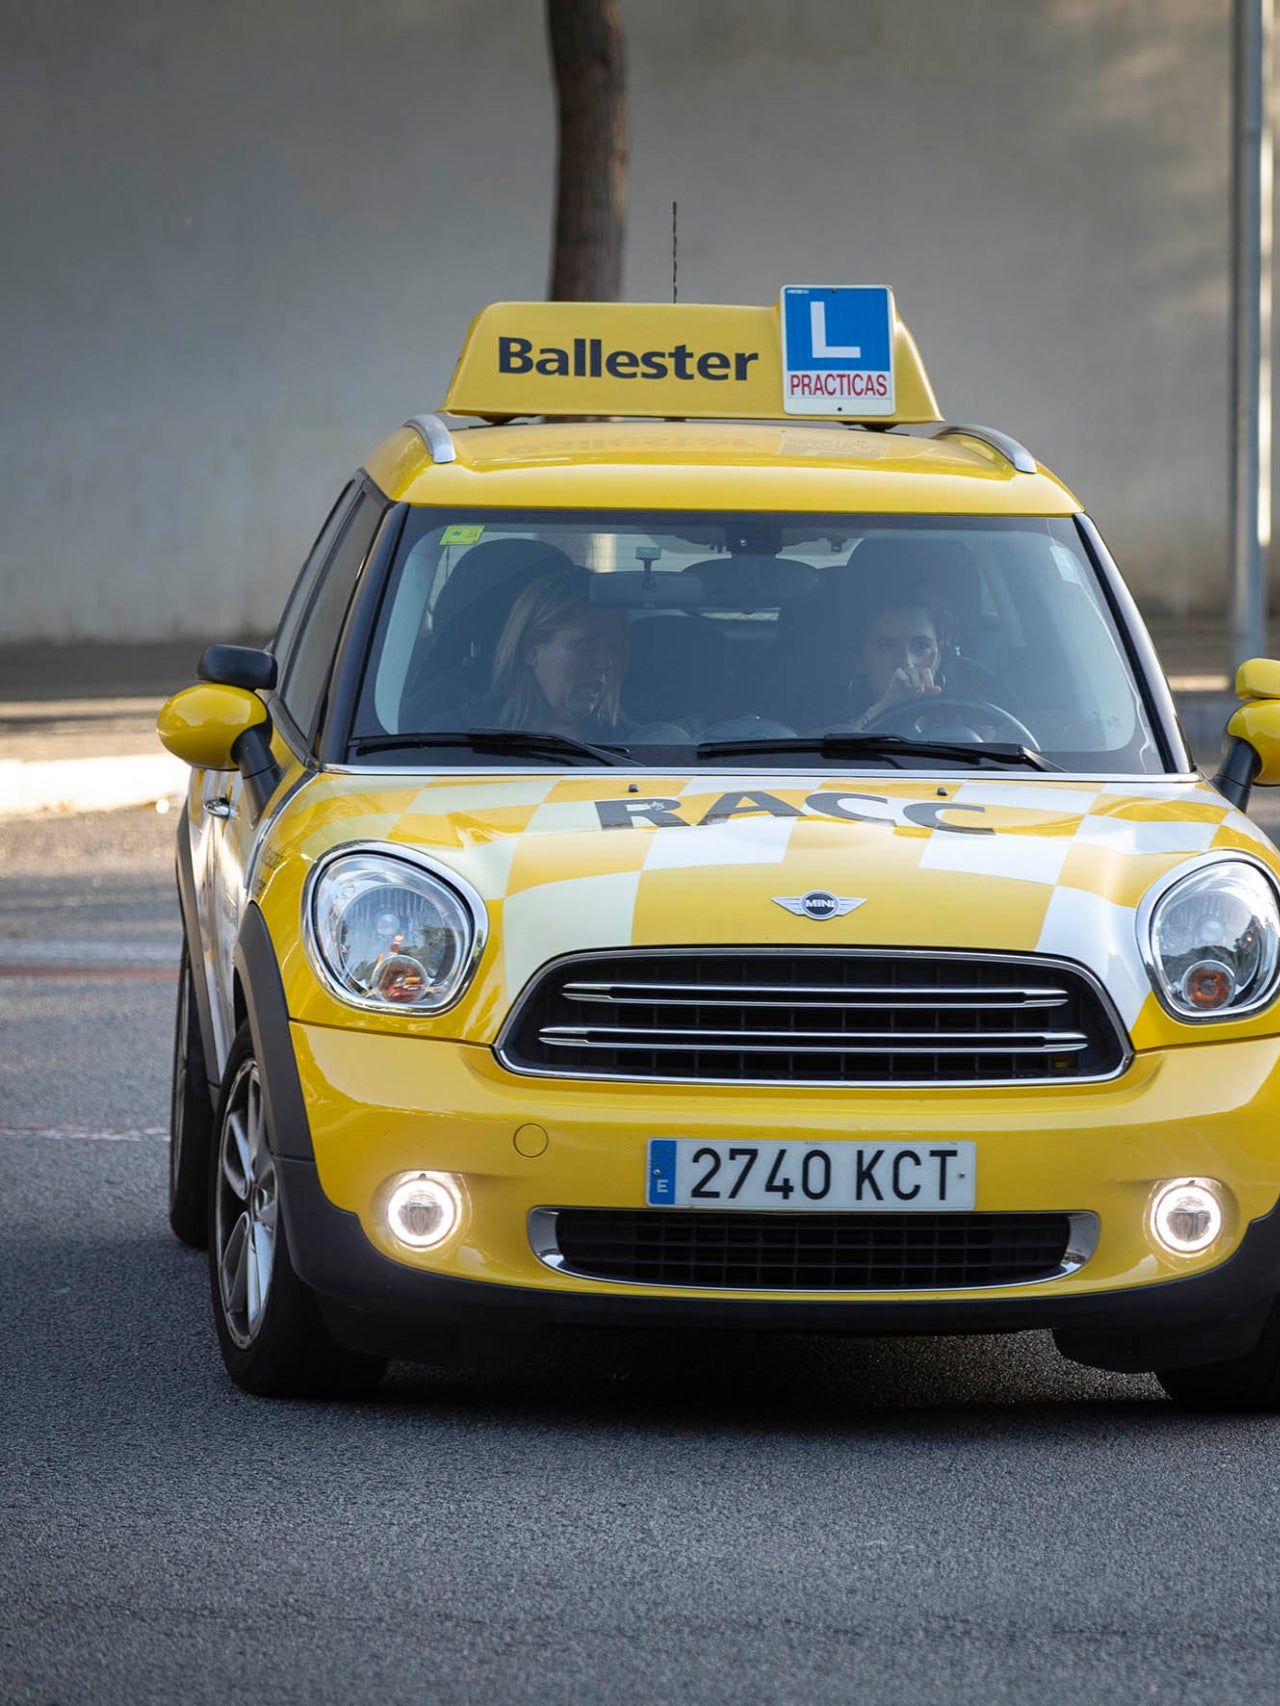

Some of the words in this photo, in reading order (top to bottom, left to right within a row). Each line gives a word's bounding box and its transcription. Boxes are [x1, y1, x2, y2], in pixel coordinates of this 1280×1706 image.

[810, 301, 861, 358] L
[498, 336, 759, 382] Ballester
[790, 374, 888, 397] PRACTICAS
[594, 790, 996, 836] RACC
[805, 899, 836, 908] MINI
[657, 1179, 669, 1193] E
[691, 1148, 831, 1200] 2740
[856, 1149, 958, 1201] KCT
